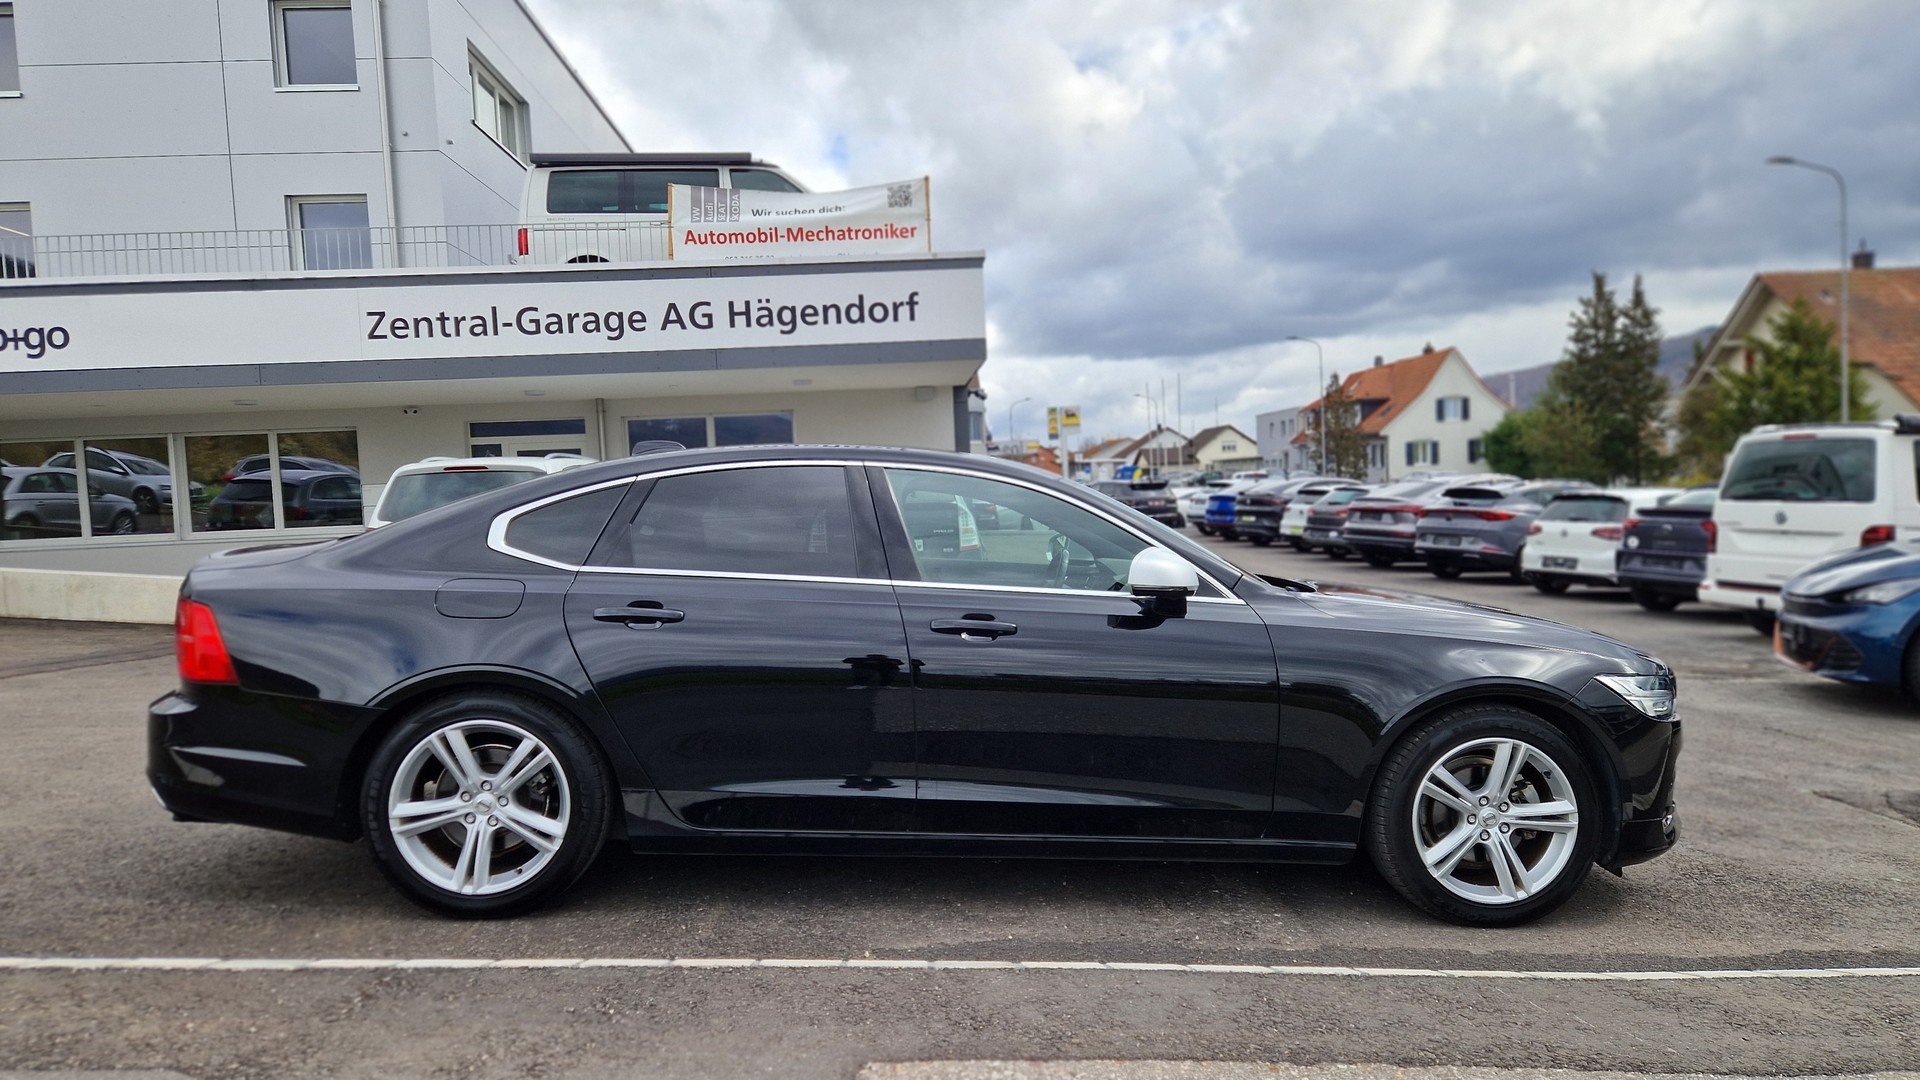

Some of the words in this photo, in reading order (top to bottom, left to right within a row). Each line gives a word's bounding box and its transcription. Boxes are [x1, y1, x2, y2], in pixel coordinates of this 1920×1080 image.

[692, 207, 701, 222] VW
[705, 202, 714, 222] Audi
[718, 202, 726, 221] SEAT
[751, 208, 772, 217] Wir
[775, 208, 815, 216] suchen
[684, 223, 917, 246] Automobil-Mechatroniker
[366, 306, 647, 341] Zentral-Garage
[660, 301, 714, 331] AG
[728, 291, 919, 335] Hägendorf
